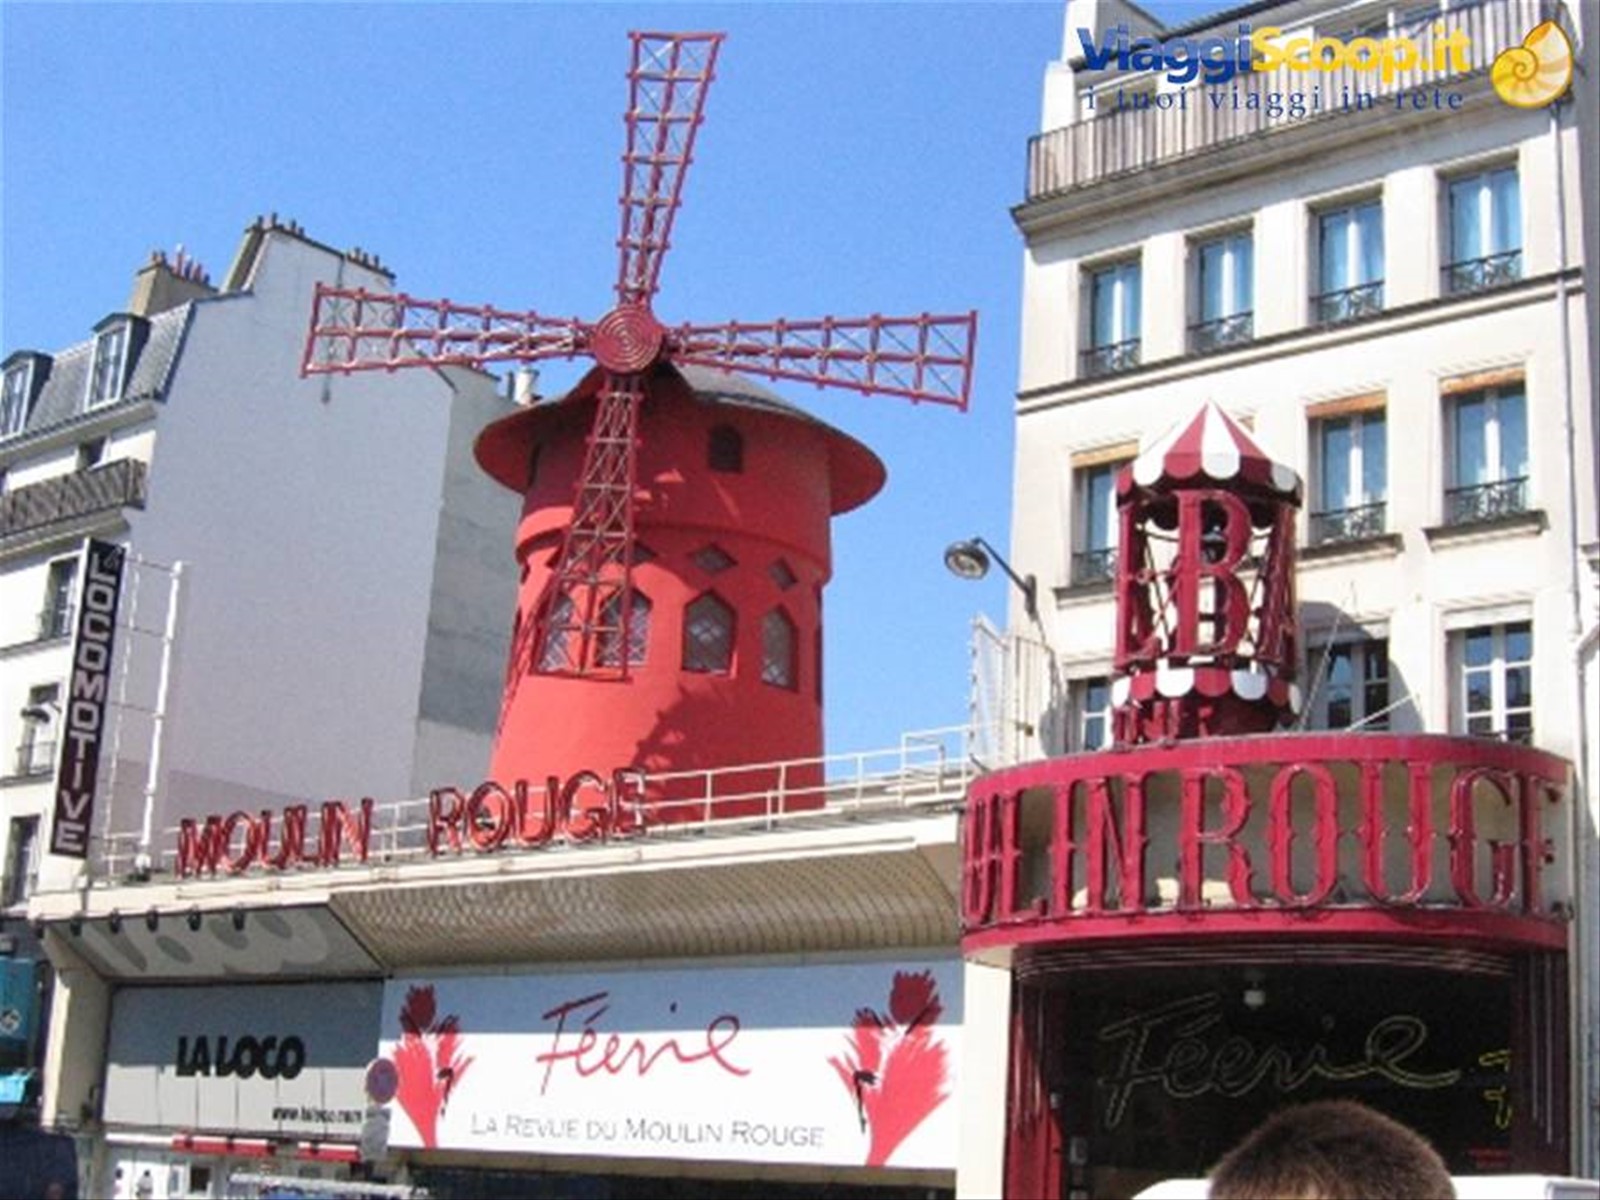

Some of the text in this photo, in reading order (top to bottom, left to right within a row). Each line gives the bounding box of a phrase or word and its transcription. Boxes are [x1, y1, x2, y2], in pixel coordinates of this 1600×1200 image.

[53, 552, 118, 852] LOCOMOTIVE
[176, 766, 646, 879] MOULIN ROUGE
[1178, 762, 1563, 914] ROUGE
[175, 1034, 306, 1081] LA LOCO
[624, 1117, 723, 1144] MOULIN
[730, 1120, 826, 1148] ROUGE
